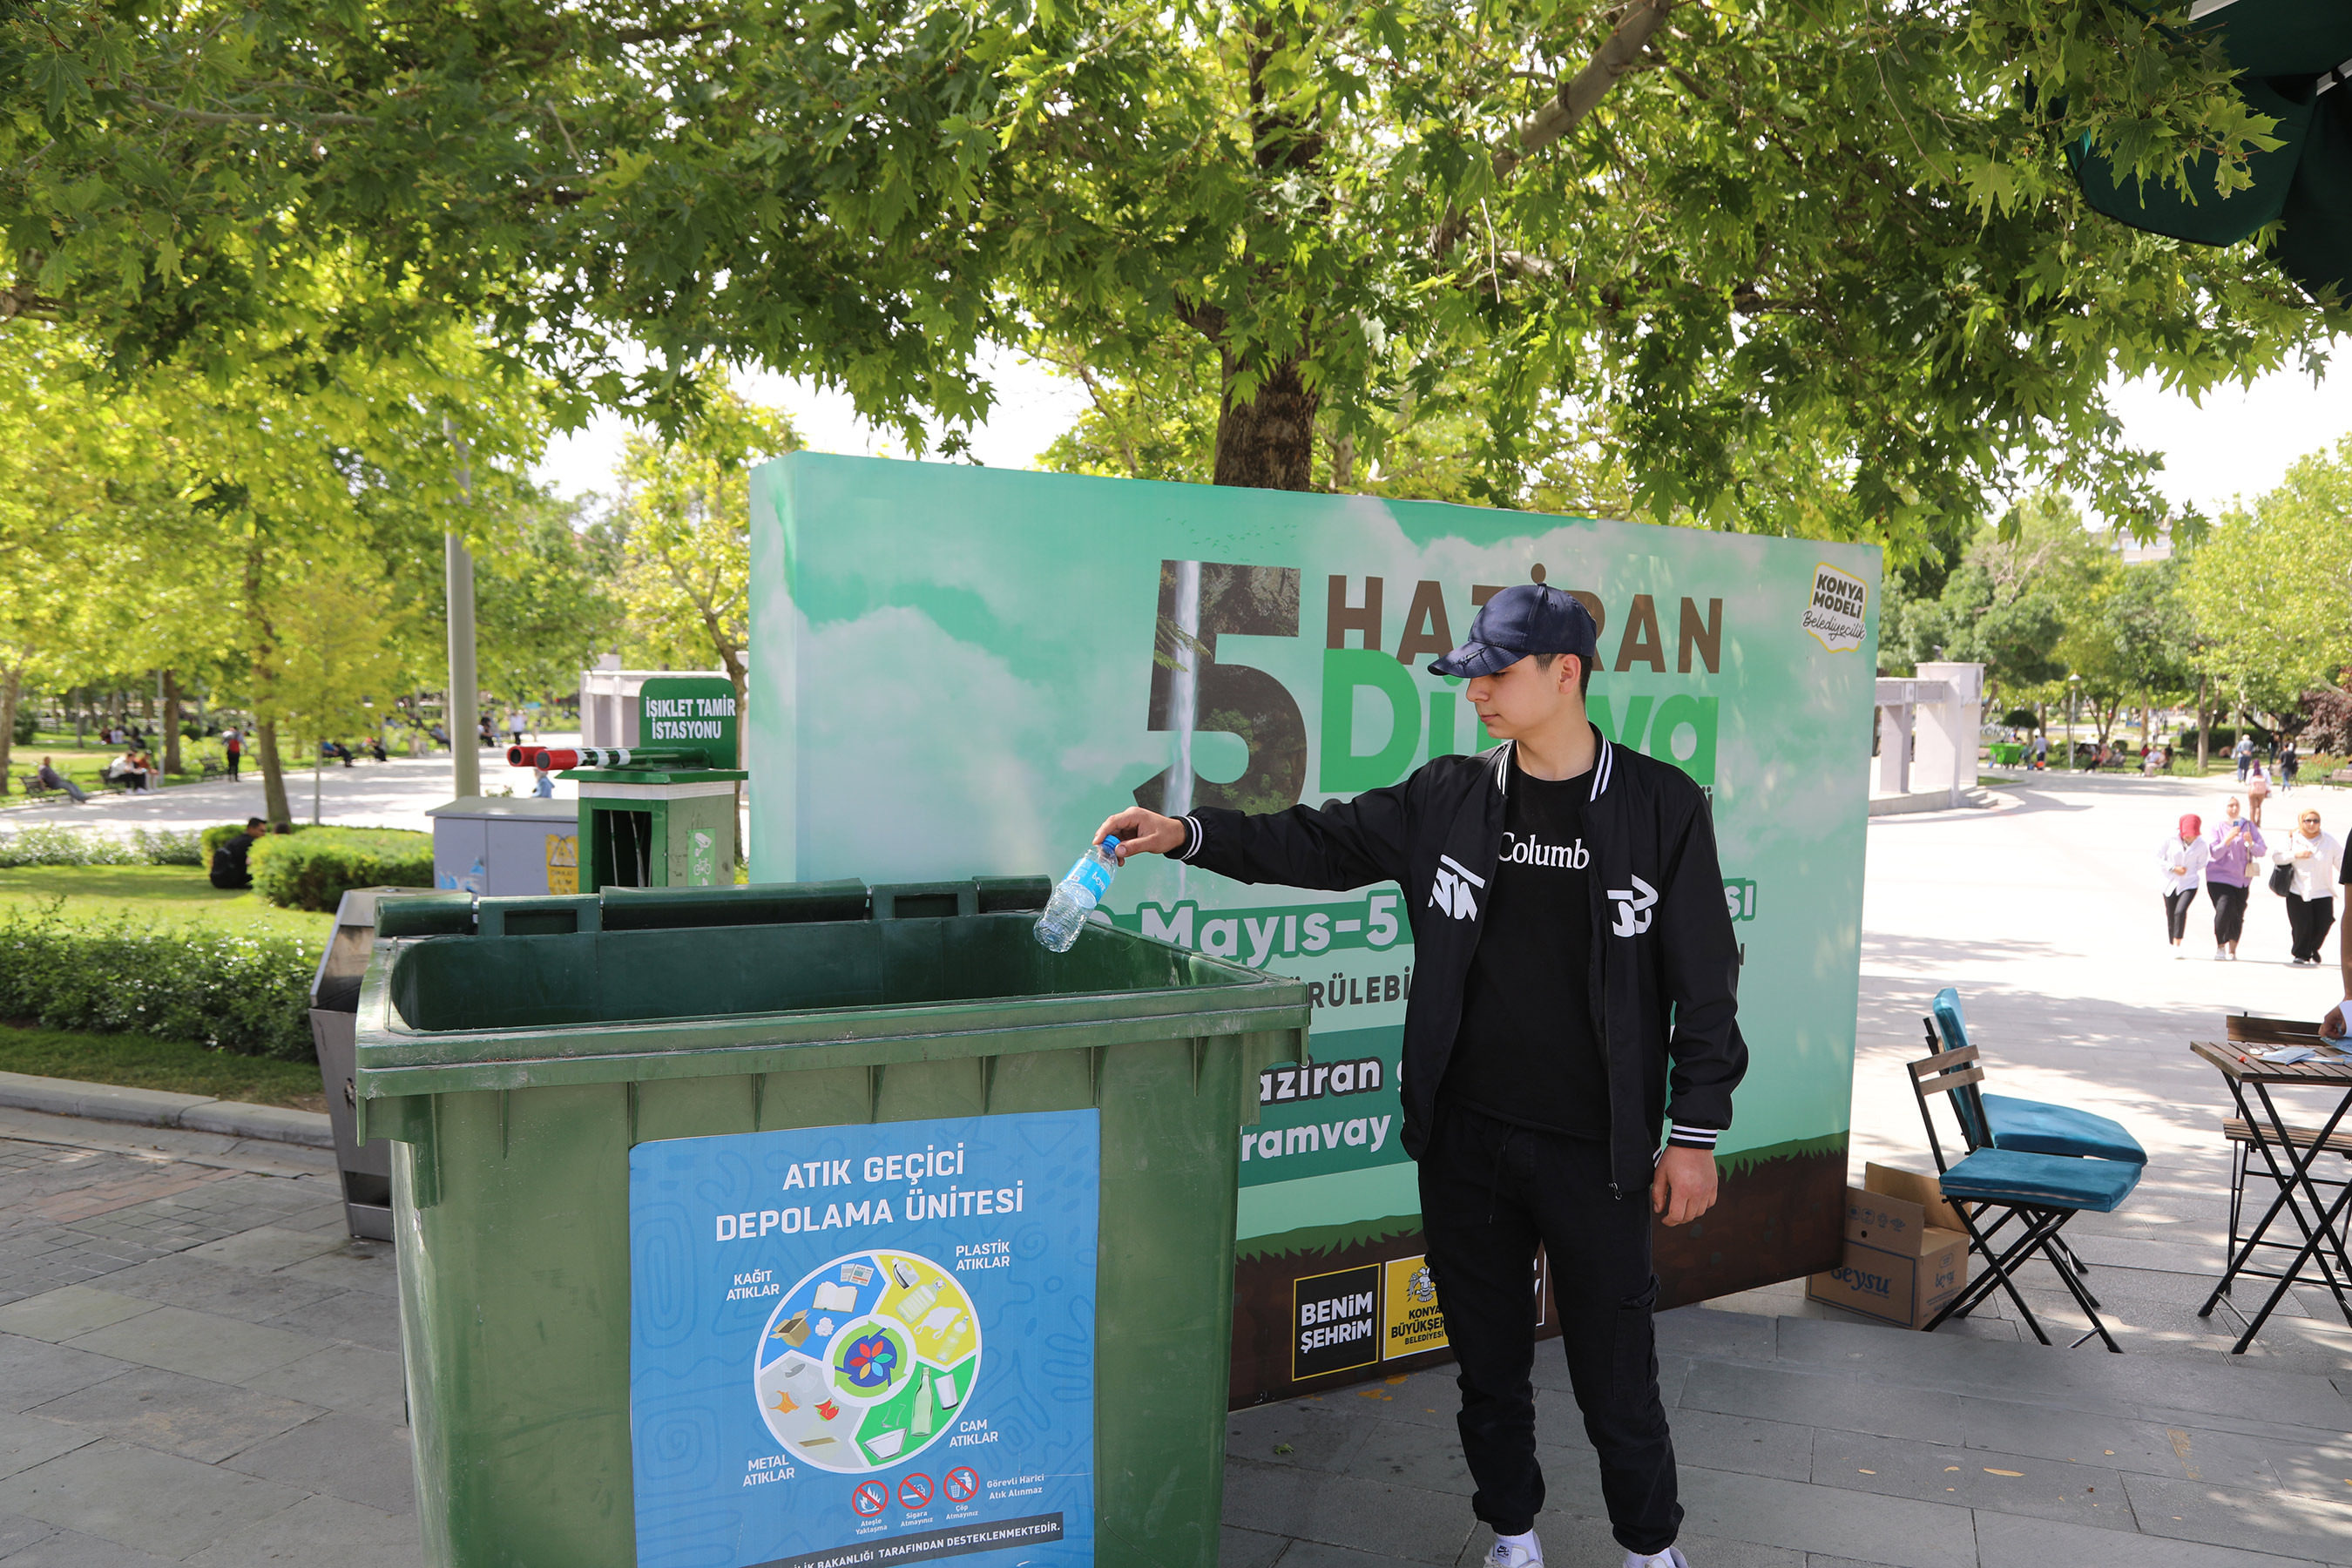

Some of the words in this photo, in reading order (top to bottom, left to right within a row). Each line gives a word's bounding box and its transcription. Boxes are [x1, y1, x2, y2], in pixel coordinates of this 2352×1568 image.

[1816, 573, 1864, 603] KONYA
[1802, 610, 1866, 641] Belediyecilik
[1132, 559, 1308, 815] 5
[1326, 563, 1723, 674] HARAN
[696, 693, 736, 717] TAMİR
[652, 717, 722, 740] İSTASYONU
[1498, 831, 1591, 870] Columb
[1260, 1059, 1382, 1102] aziran
[1240, 1114, 1392, 1162] ramvay
[782, 1159, 853, 1191] ATIK
[863, 1142, 964, 1186] GEÇİCİ
[715, 1199, 894, 1242] DEPOLAMA
[905, 1179, 1024, 1221] ÜNİTESİ
[956, 1239, 1010, 1257] PLASTİK
[956, 1255, 1010, 1272] ATIKLAR
[733, 1268, 773, 1286] KAĞIT
[726, 1283, 781, 1301] ATIKLAR
[1404, 1329, 1444, 1345] BELEDİYESİ
[960, 1418, 988, 1433] CAM
[949, 1431, 999, 1448] ATIKLAR
[747, 1454, 790, 1471] METAL
[742, 1467, 795, 1487] ATIKLAR
[986, 1477, 1017, 1488] Görevli
[1019, 1473, 1044, 1484] Harici
[989, 1490, 1006, 1500] Atık
[1008, 1486, 1044, 1497] Alınmaz
[906, 1511, 928, 1520] Sigara
[945, 1511, 979, 1521] Atmayınız
[955, 1504, 969, 1513] Çöp
[855, 1524, 888, 1536] Yaklaşma
[861, 1518, 882, 1528] Ateşle
[900, 1517, 934, 1528] Atmayınız
[817, 1550, 875, 1568] BAKANLIĞI
[878, 1538, 944, 1559] TARAFINDAN
[947, 1521, 1060, 1547] DESTEKLENMEKTEDİR.
